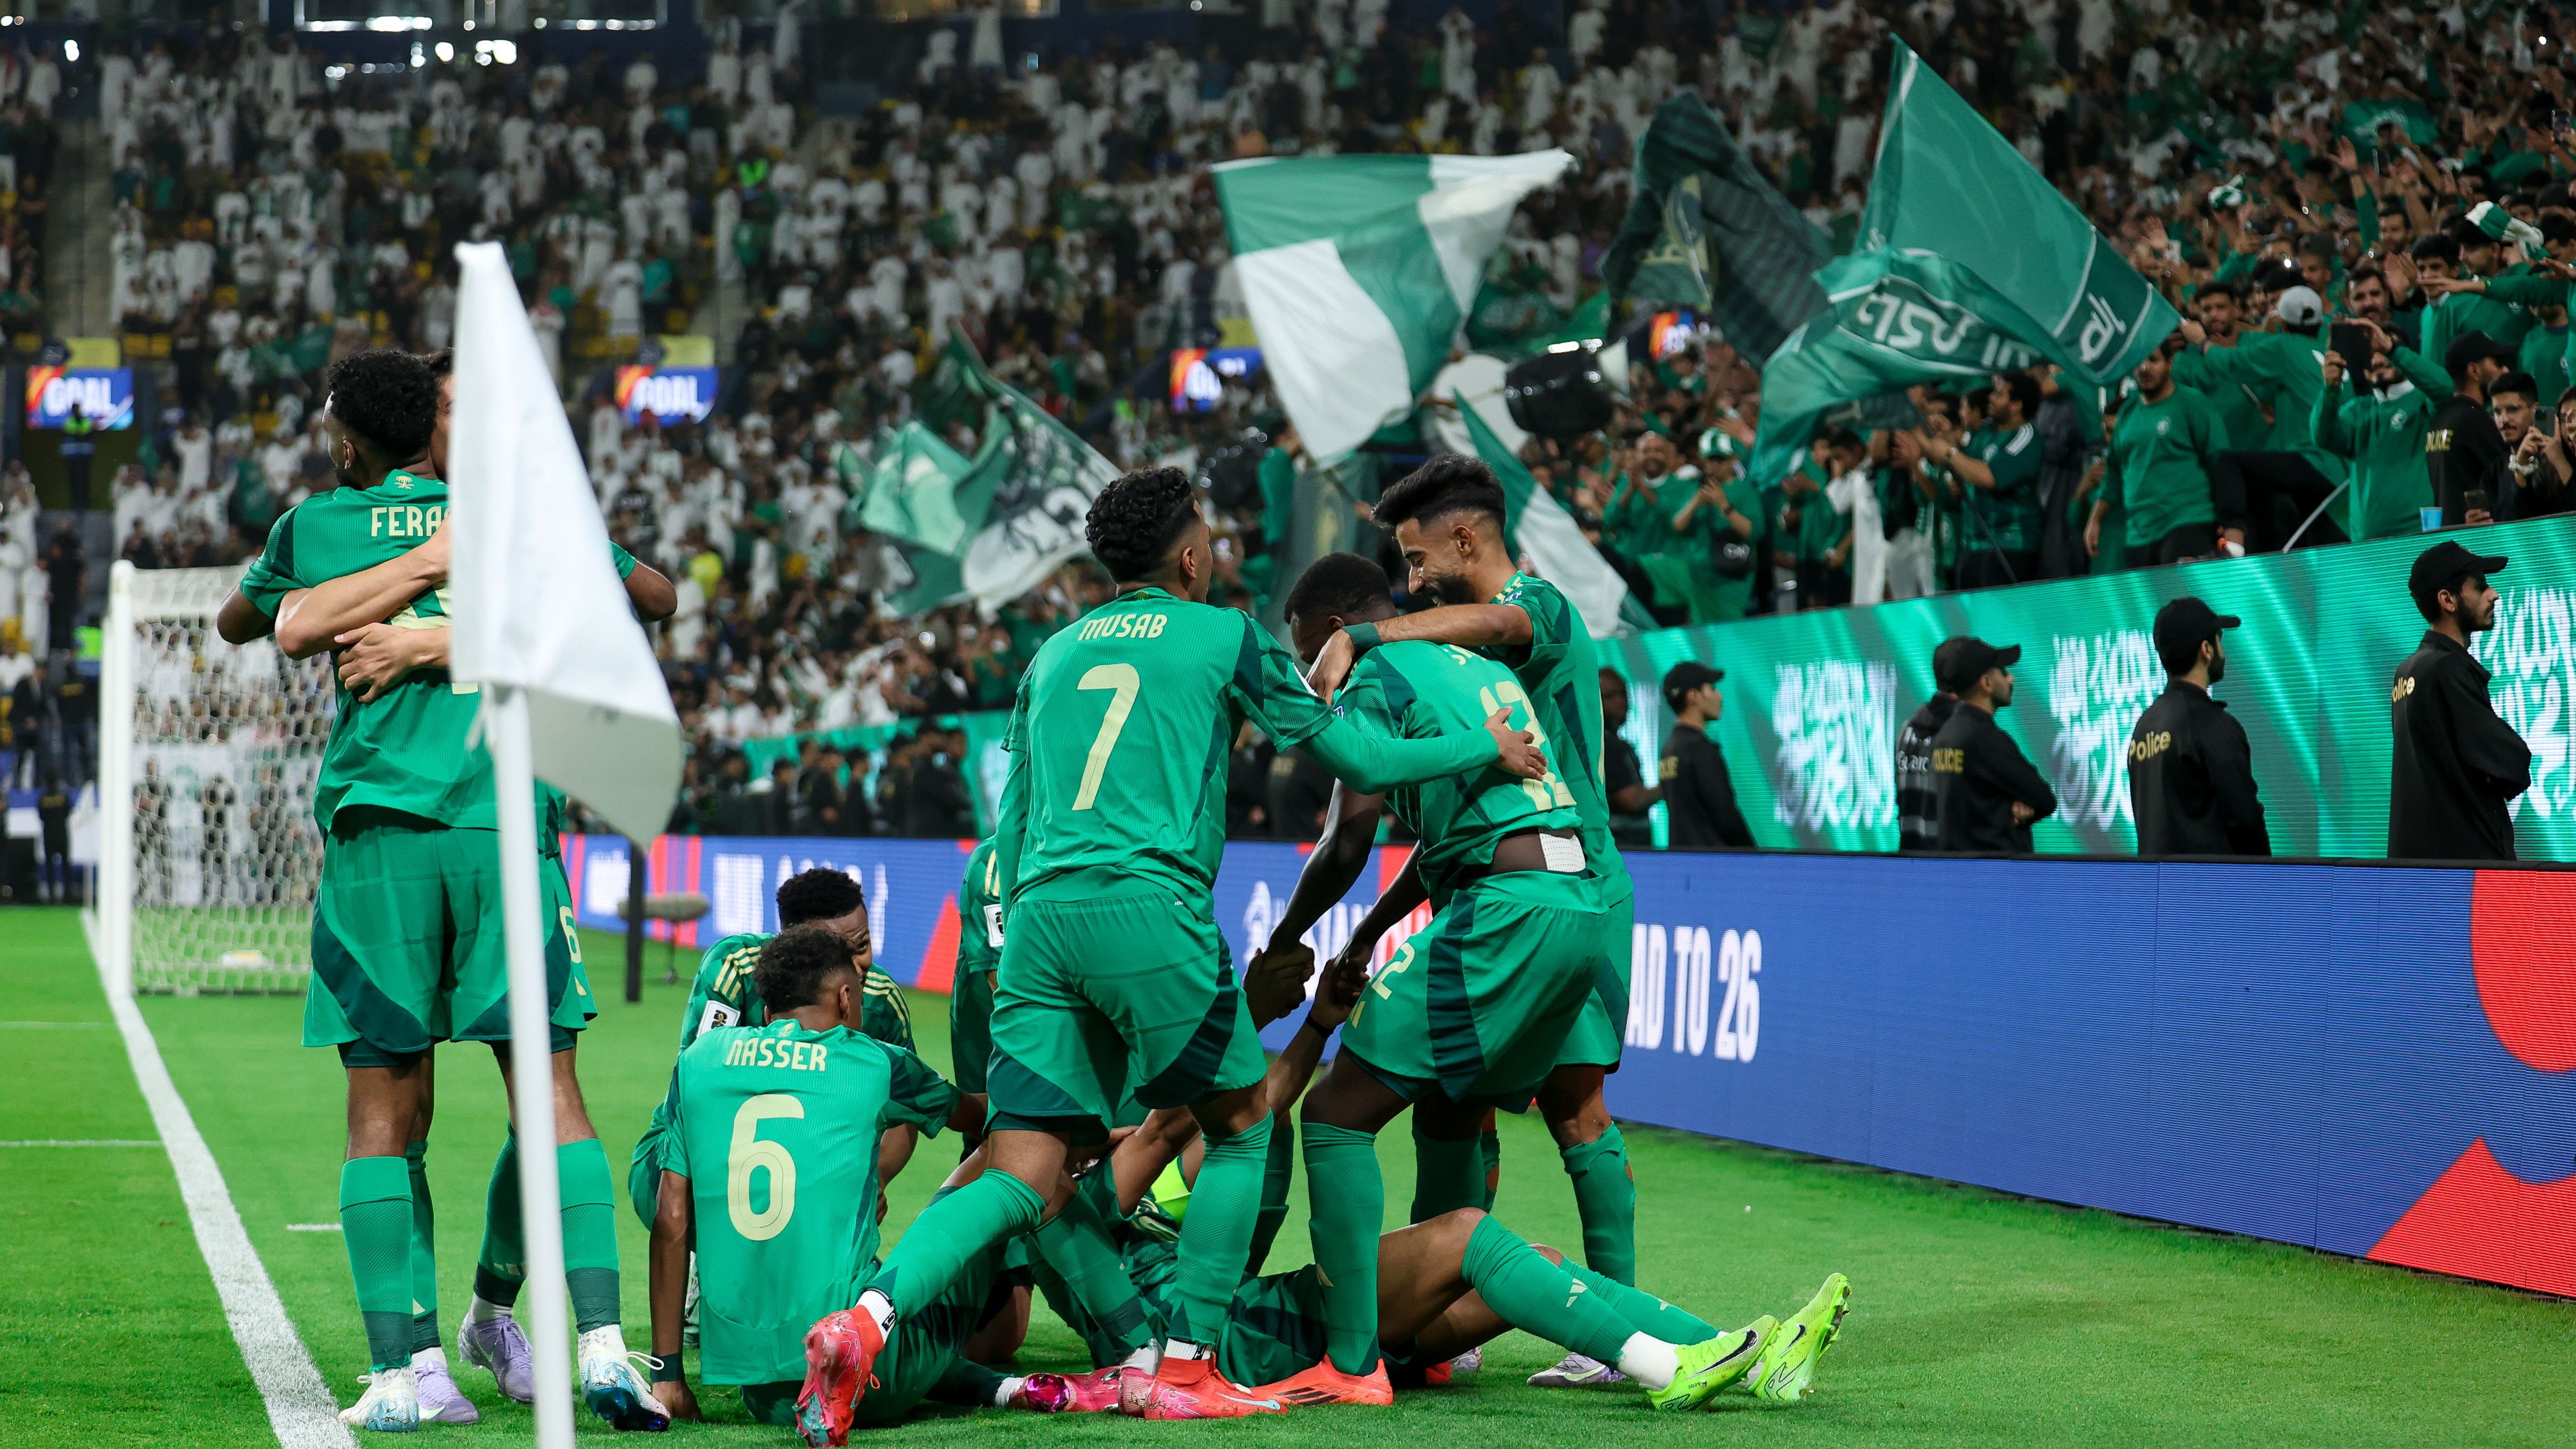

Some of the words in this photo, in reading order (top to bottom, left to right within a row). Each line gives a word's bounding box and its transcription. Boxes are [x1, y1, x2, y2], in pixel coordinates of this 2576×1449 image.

[44, 376, 117, 417] GOAL
[634, 375, 704, 416] GOAL
[371, 505, 449, 537] FERA
[1078, 614, 1167, 641] MUSAB
[2392, 676, 2415, 702] olice
[1072, 663, 1140, 810] 7
[2129, 730, 2171, 765] Police
[1933, 748, 1964, 774] OLICE
[559, 905, 582, 964] 6
[1370, 942, 1415, 1000] 2
[1624, 923, 1667, 1049] AD
[1673, 925, 1711, 1056] TO
[1714, 928, 1762, 1063] 26
[725, 1038, 828, 1072] NASSER
[728, 1094, 804, 1241] 6
